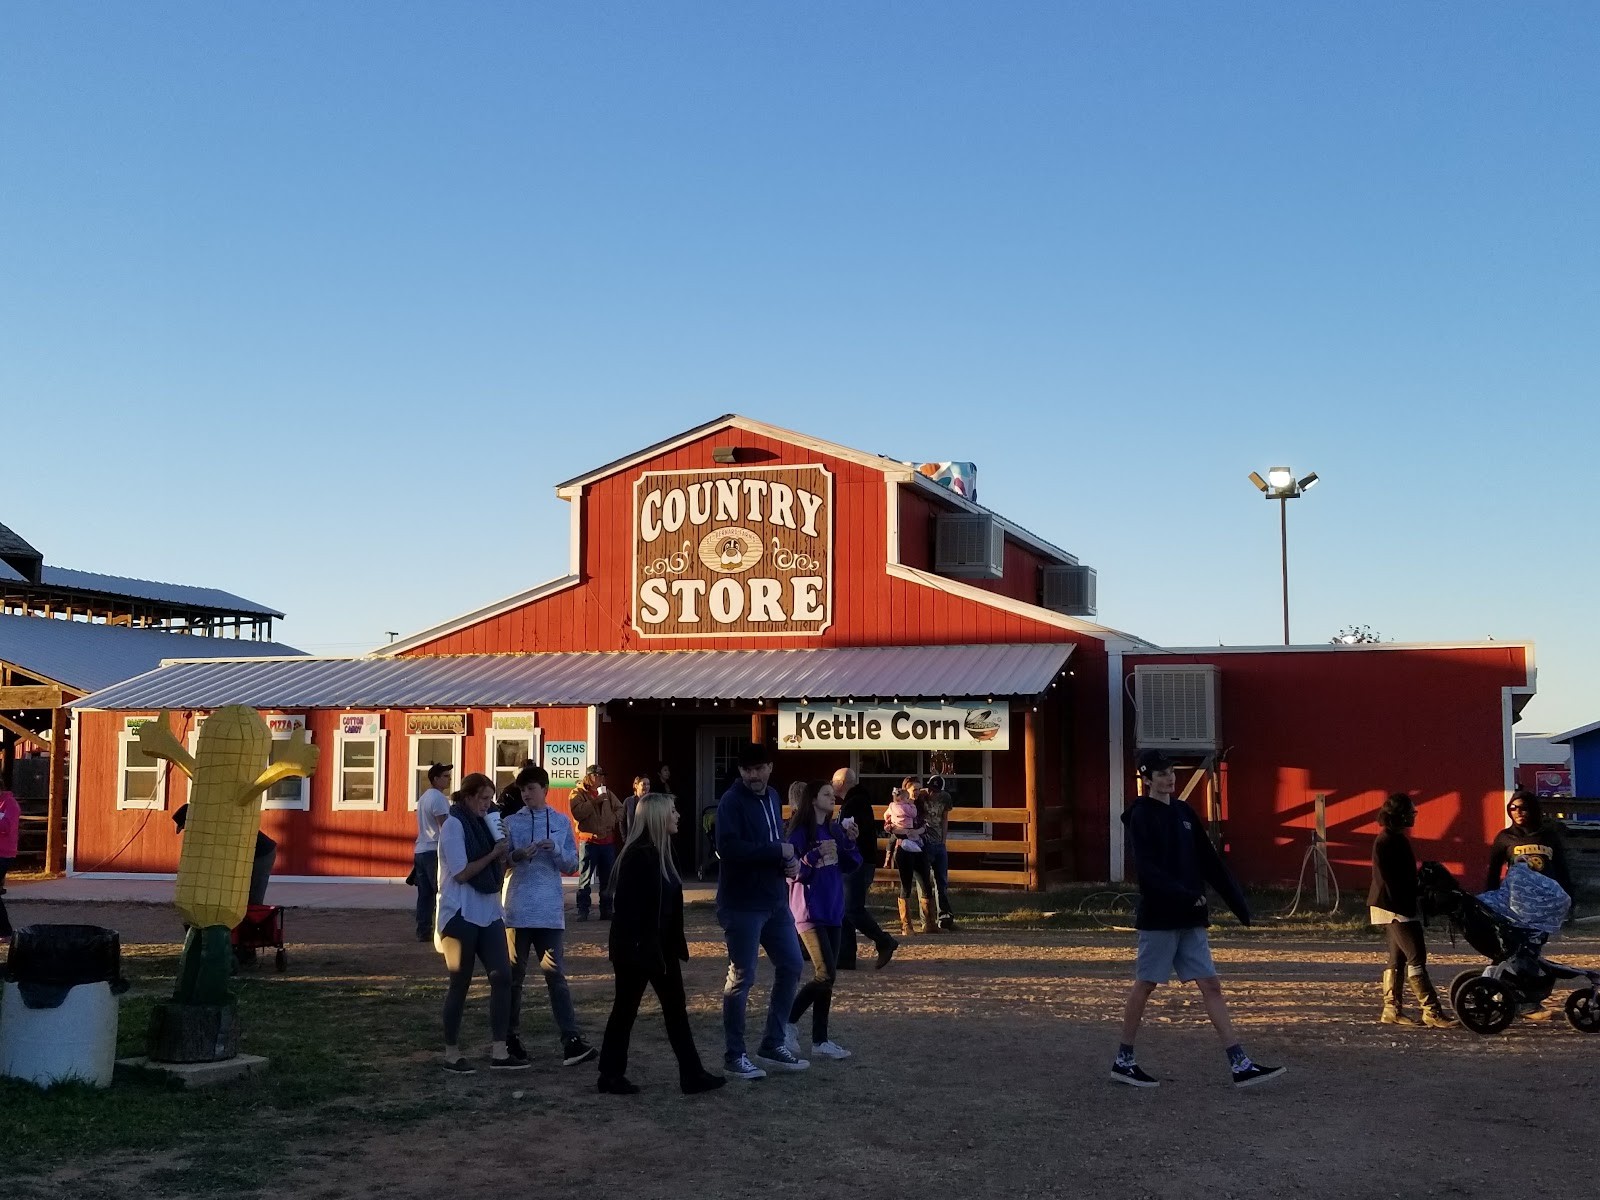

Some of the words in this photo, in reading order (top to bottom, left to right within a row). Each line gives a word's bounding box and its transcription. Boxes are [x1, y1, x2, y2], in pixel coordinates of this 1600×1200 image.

[641, 478, 823, 542] COUNTRY
[716, 528, 737, 539] BERNARD
[640, 576, 824, 624] STORE
[270, 719, 292, 729] PIZZA
[343, 717, 364, 725] COTTON
[494, 716, 526, 730] TOKENS
[795, 712, 882, 740] Kettle
[891, 711, 960, 740] Corn
[344, 725, 362, 734] CANDY
[546, 744, 585, 753] TOKENS
[551, 757, 580, 766] SOLD
[551, 769, 580, 779] HERE
